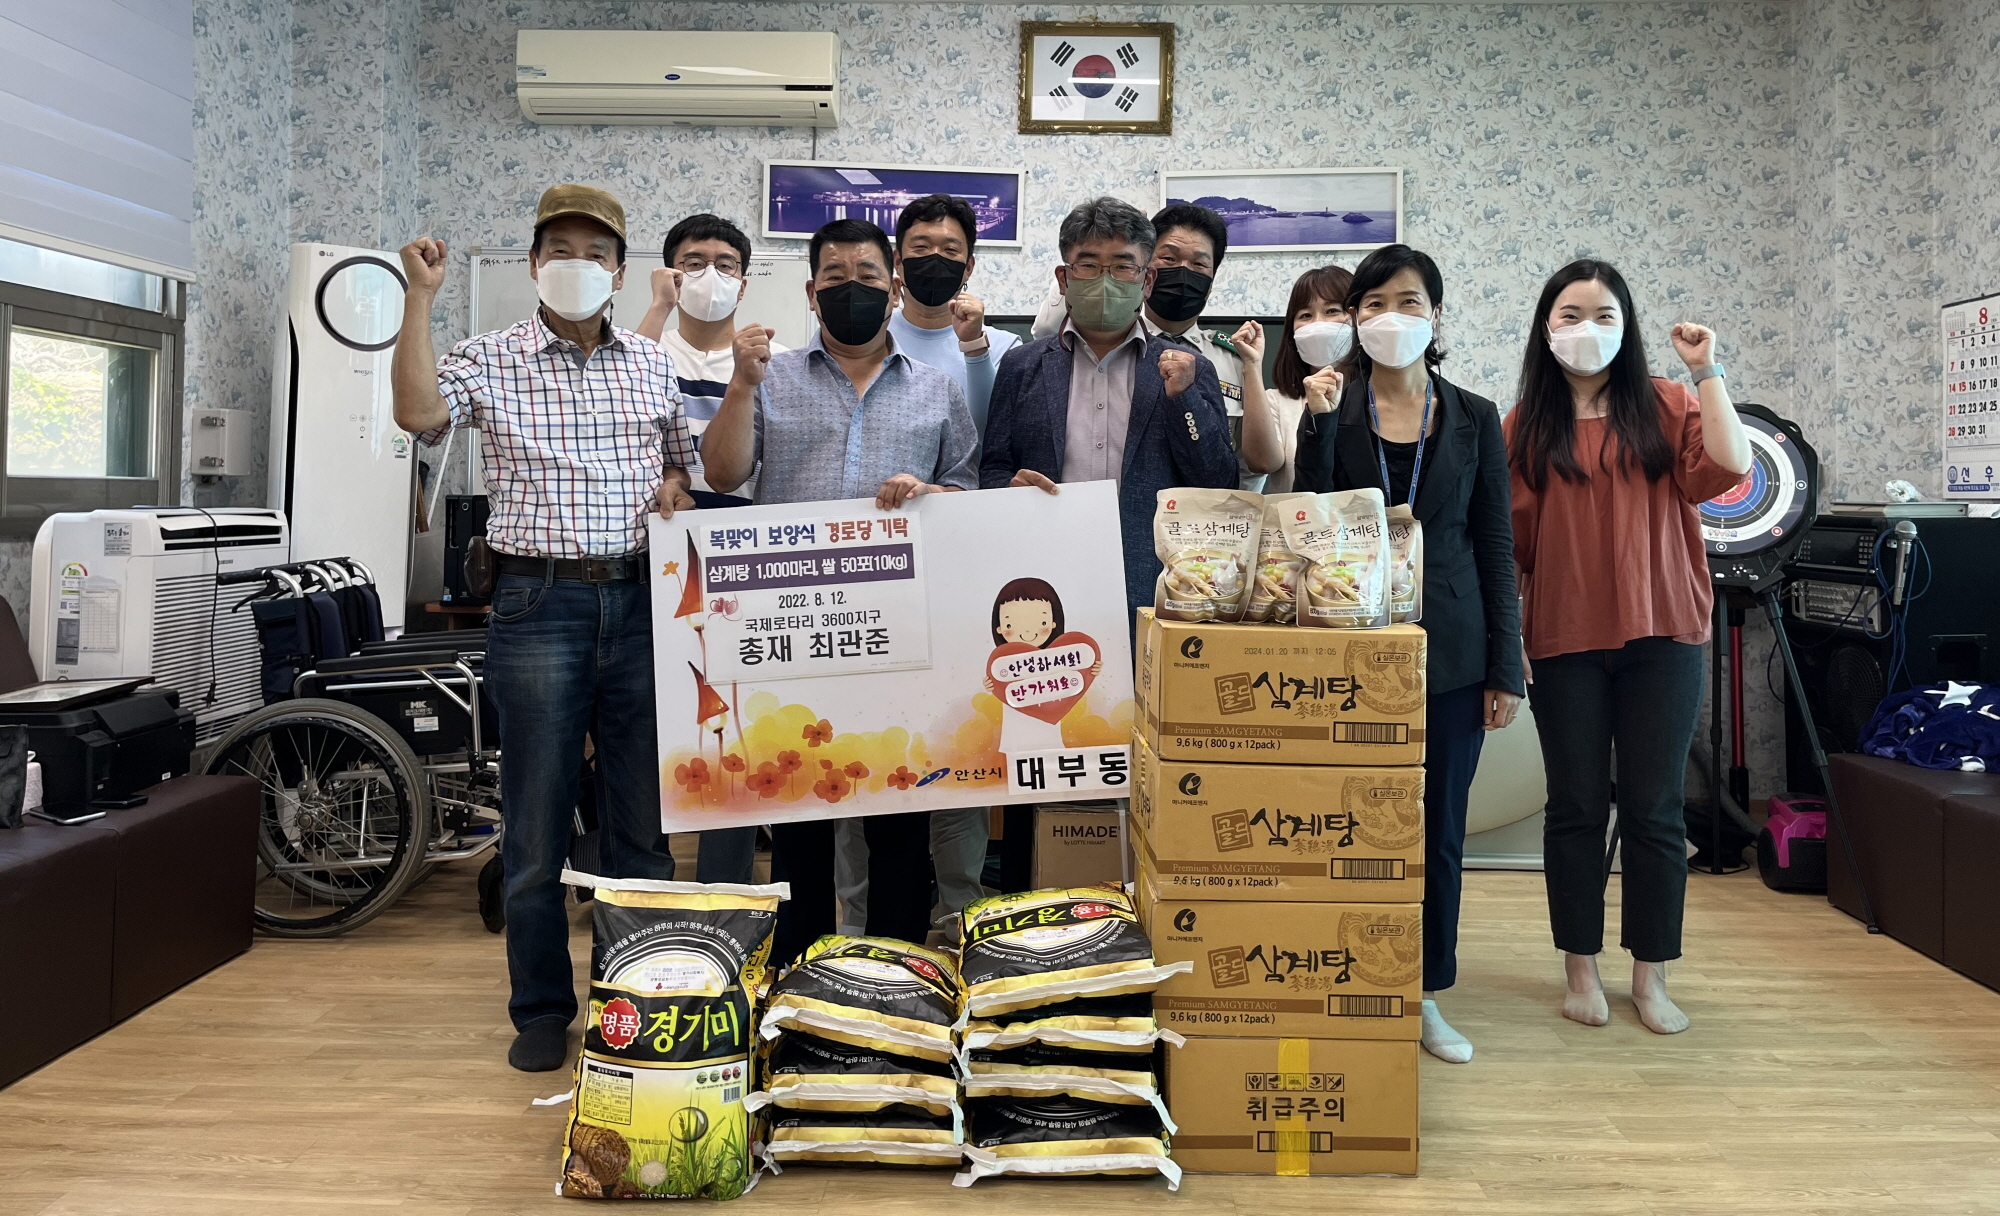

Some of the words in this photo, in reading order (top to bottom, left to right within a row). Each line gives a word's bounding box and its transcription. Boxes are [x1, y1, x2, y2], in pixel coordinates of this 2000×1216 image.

[1979, 307, 1988, 325] 8
[1980, 357, 1987, 367] 10
[1991, 355, 1997, 366] 11
[1949, 383, 1956, 393] 14
[1959, 382, 1966, 392] 15
[1969, 380, 1976, 391] 16
[1979, 379, 1987, 389] 17
[1990, 378, 1998, 388] 18
[1949, 405, 1956, 415] 21
[1958, 404, 1966, 414] 22
[1968, 402, 1976, 413] 23
[1979, 402, 1986, 412] 24
[1989, 400, 1997, 411] 25
[1948, 426, 1956, 436] 28
[1958, 426, 1966, 436] 29
[1968, 426, 1976, 435] 30
[1979, 424, 1985, 434] 31
[710, 528, 757, 550] 복맞이
[768, 524, 815, 546] 보양식
[825, 520, 872, 543] 경로당
[877, 518, 908, 538] 기탁
[708, 564, 750, 583] 삼계탕
[821, 558, 836, 575] 쌀
[778, 594, 809, 609] 2022.
[814, 593, 825, 606] 8.
[830, 591, 847, 605] 12.
[745, 615, 814, 633] 국제로타리
[821, 609, 881, 627] 3600지구
[739, 634, 792, 666] 총재
[809, 628, 890, 659] 최관준
[1244, 647, 1288, 655] 2024.01.20
[1293, 647, 1308, 655] 까지
[1252, 671, 1363, 711] 삼계탕
[1175, 726, 1211, 734] Premium
[1214, 727, 1283, 736] SAMGYETANG
[1176, 738, 1190, 747] 9.6
[1192, 738, 1202, 748] kg
[954, 767, 1002, 781] 안산시
[1016, 751, 1128, 790] 대부동
[1052, 825, 1118, 838] HIMADE
[1249, 808, 1360, 847] 삼계탕
[1173, 864, 1209, 872] Premium
[1212, 864, 1280, 873] SAMGYETANG
[1190, 876, 1200, 886] kg
[1245, 944, 1357, 984] 삼계탕
[1169, 1000, 1205, 1008] Premium
[1208, 1001, 1277, 1010] SAMGYETANG
[1170, 1012, 1184, 1022] 9.6
[1186, 1012, 1197, 1023] kg
[603, 1011, 637, 1037] 명품
[643, 1001, 740, 1053] 경기미
[1246, 1096, 1345, 1122] 취급주의
